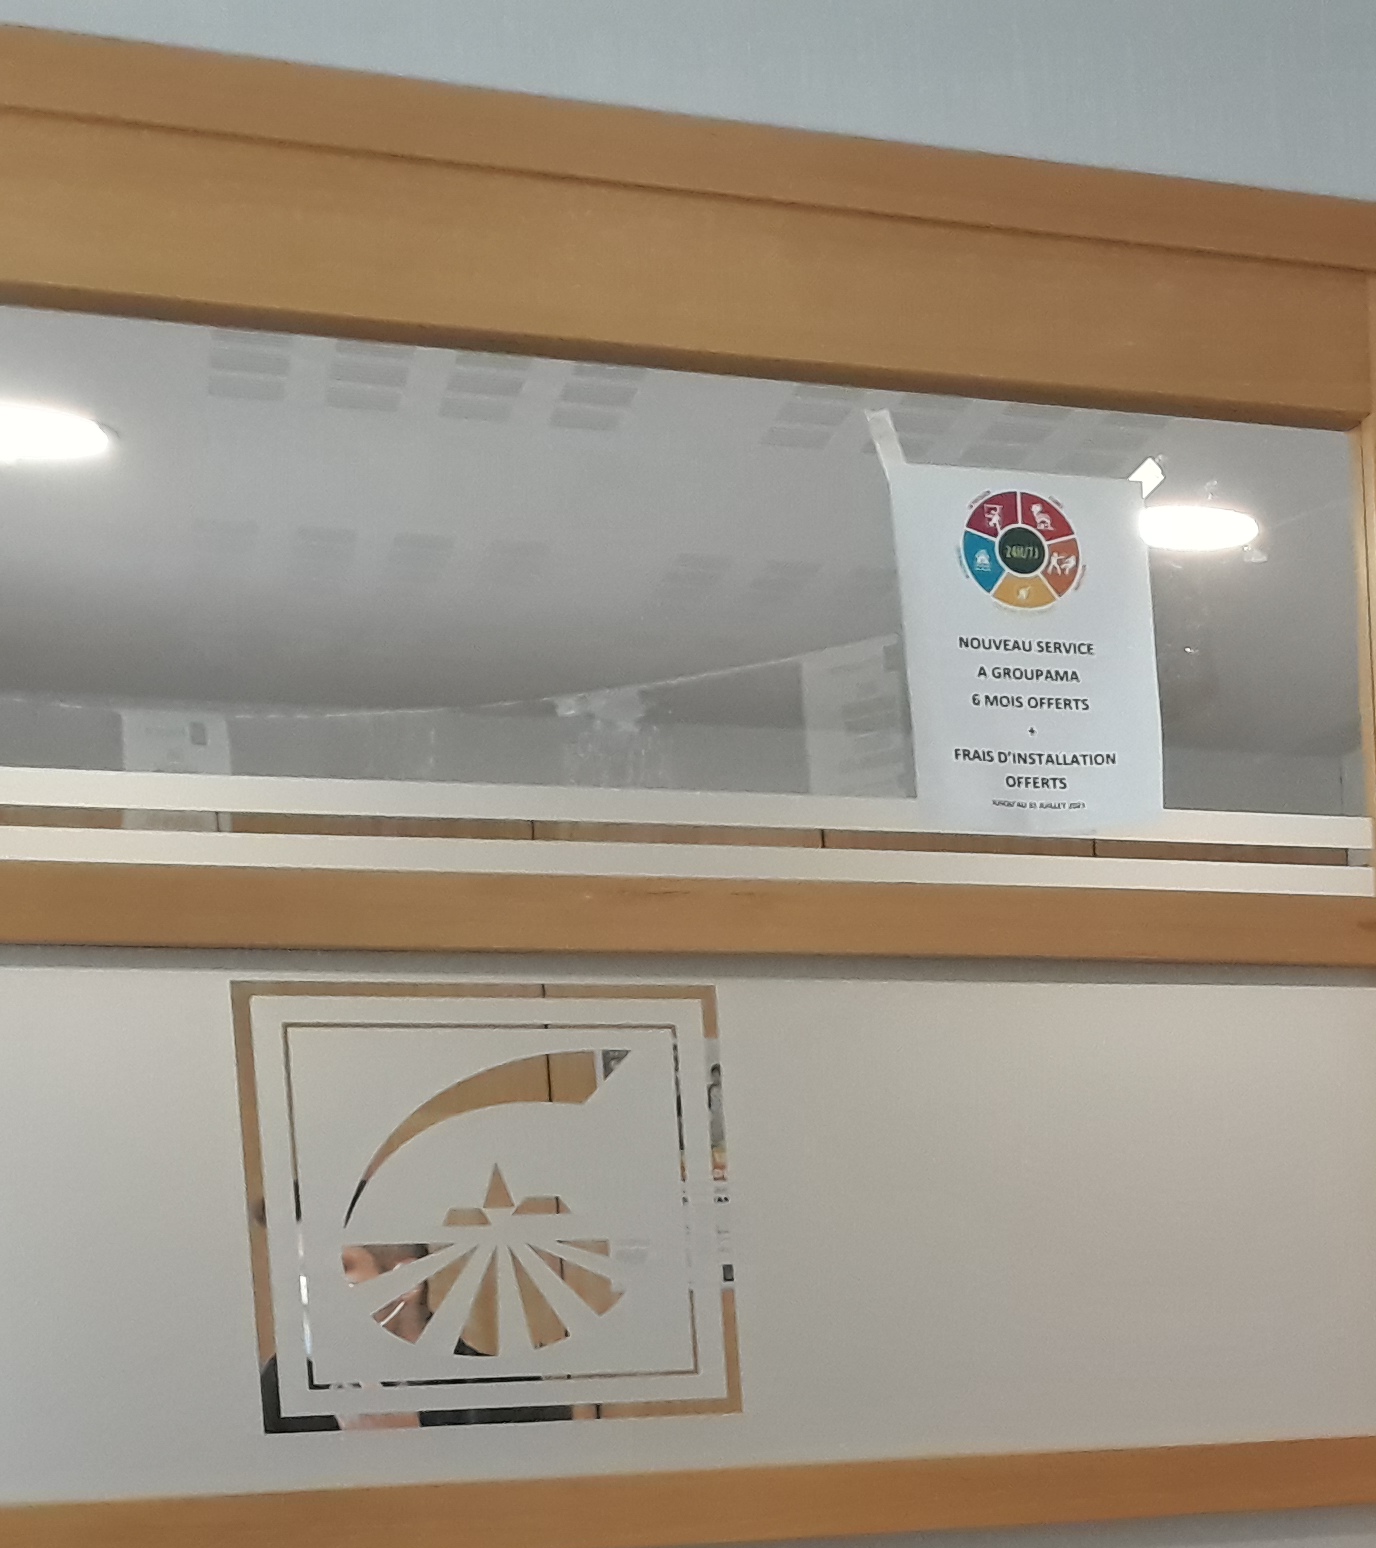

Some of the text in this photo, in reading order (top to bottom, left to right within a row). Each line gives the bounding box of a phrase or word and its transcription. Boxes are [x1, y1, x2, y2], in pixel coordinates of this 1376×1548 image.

[958, 636, 1095, 657] NOUVEAU SERVICE
[978, 666, 1080, 683] A GROUPAMA
[972, 694, 1090, 711] 6 MOIS OFFERTS
[954, 748, 1118, 766] FRAIS D'INSTALLATION
[1005, 775, 1068, 790] OFFERTS
